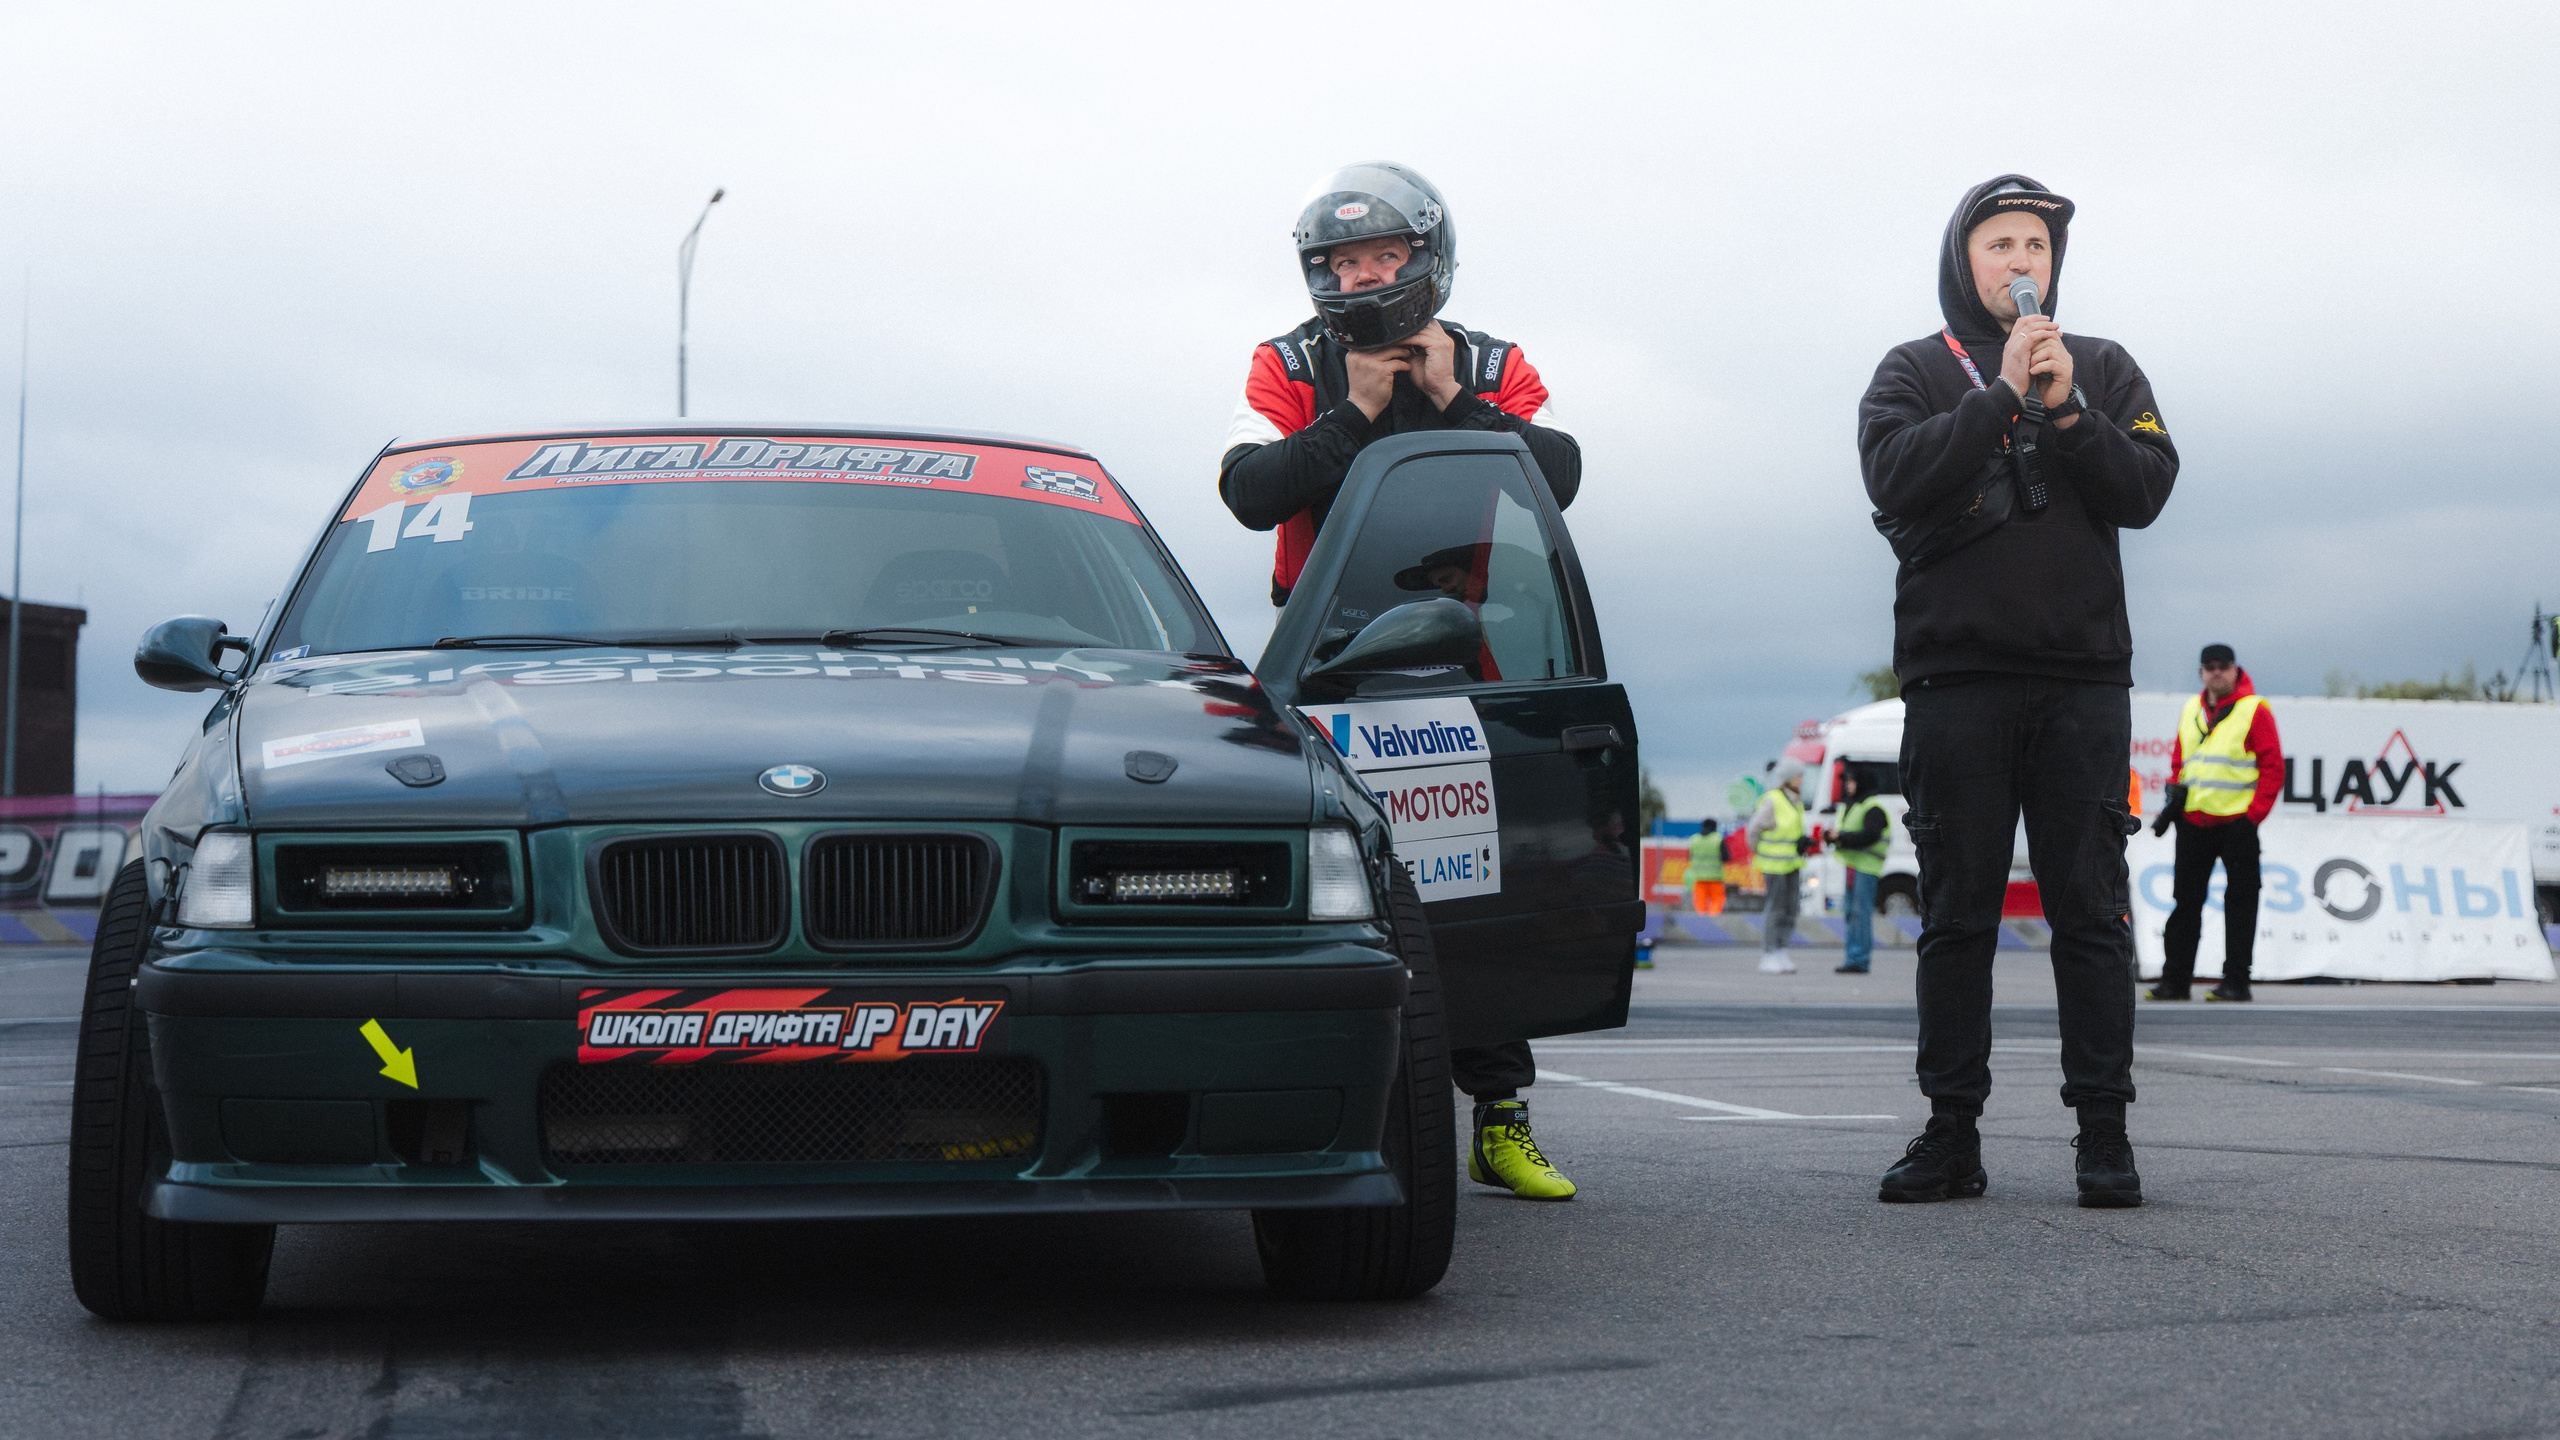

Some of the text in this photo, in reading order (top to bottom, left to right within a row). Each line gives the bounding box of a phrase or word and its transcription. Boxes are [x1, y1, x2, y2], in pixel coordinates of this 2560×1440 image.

[1340, 207, 1363, 216] BELL
[1276, 342, 1300, 370] sparco
[1485, 348, 1502, 380] sparco
[556, 470, 698, 484] РЕСПУБЛИКАНСКИЕ
[702, 470, 816, 480] СОРЕВНОВАНИЯ
[842, 474, 933, 486] ДРИФТИНГУ
[357, 492, 473, 554] 14
[459, 586, 575, 601] BRIDE
[894, 579, 993, 605] sparco
[512, 665, 1029, 685] Sports
[1357, 721, 1479, 758] Valvoline
[2283, 757, 2466, 813] ЦАУК
[1420, 853, 1473, 884] LANE
[588, 1006, 994, 1048] ШКОЛА ДРИФТА JP DAY
